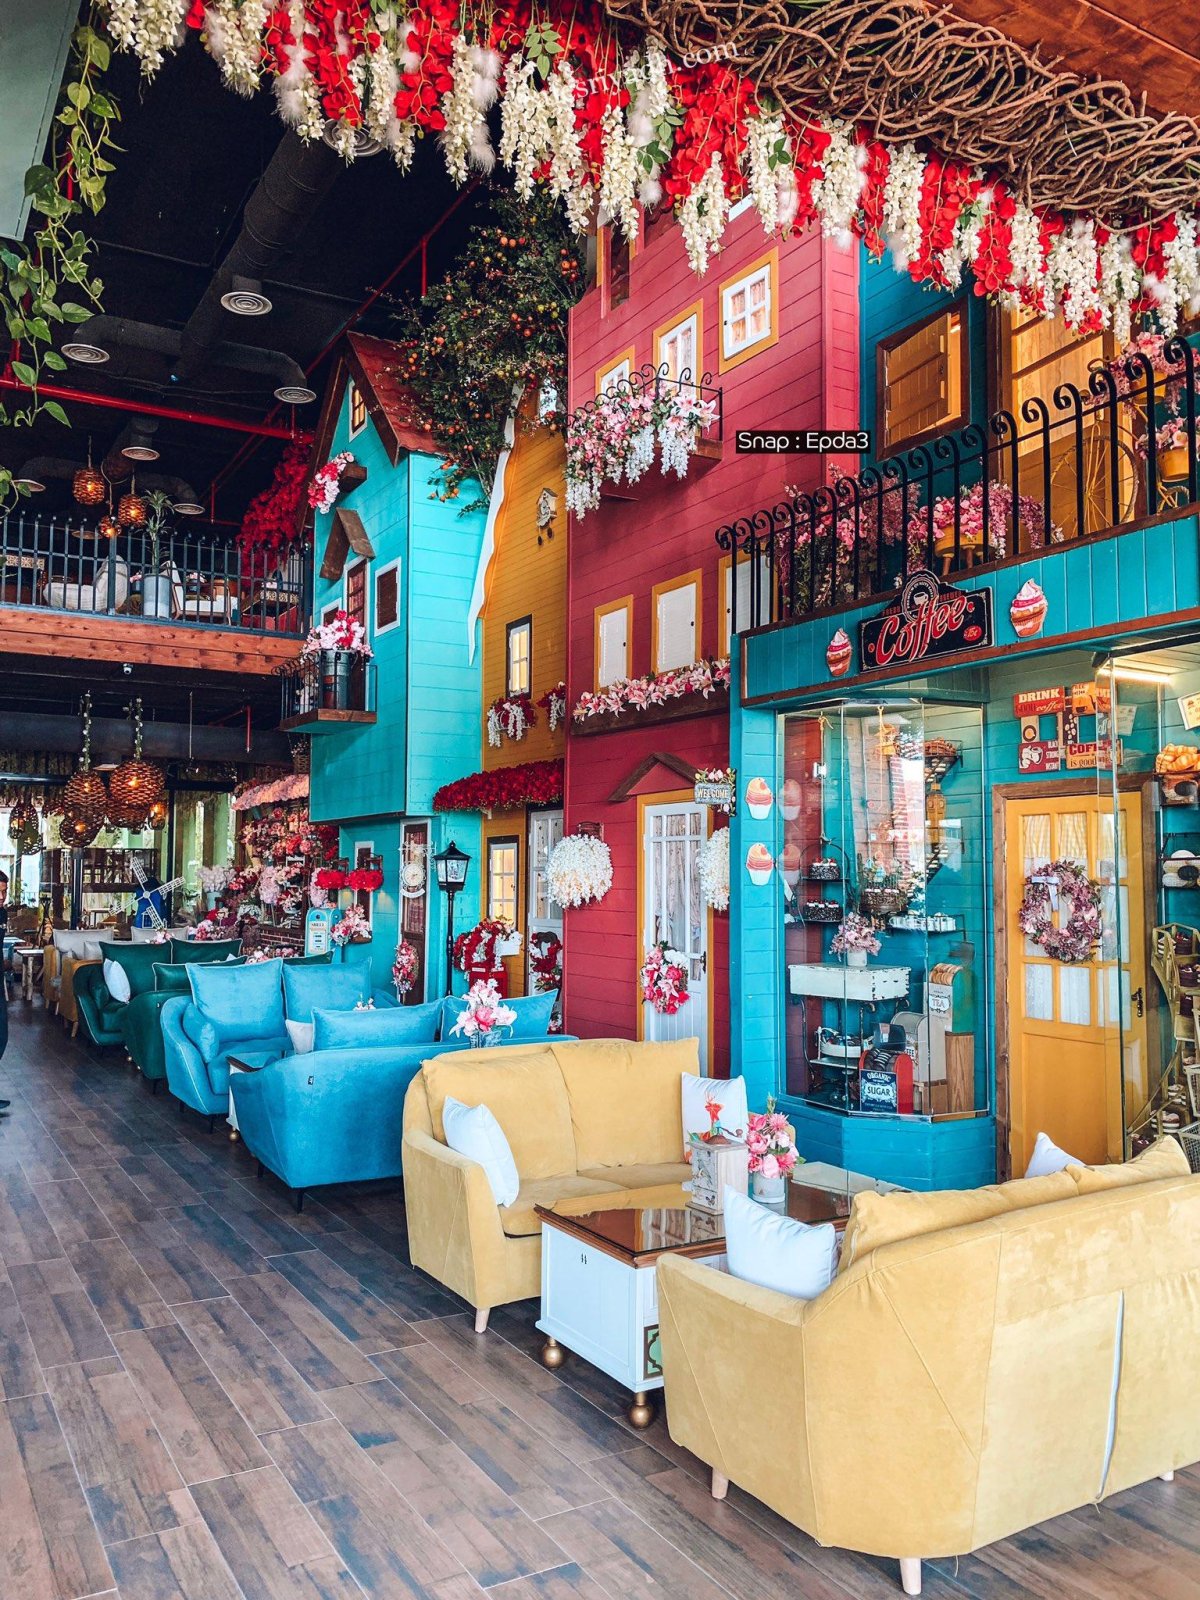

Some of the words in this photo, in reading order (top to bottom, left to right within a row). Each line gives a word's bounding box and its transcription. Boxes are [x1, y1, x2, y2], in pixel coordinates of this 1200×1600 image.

[876, 595, 967, 665] Coffee
[1018, 687, 1061, 704] DRINK
[698, 788, 729, 799] WELCOME
[932, 998, 946, 1009] TEA
[866, 1072, 892, 1083] ORGANIC
[867, 1085, 891, 1096] SUGAR
